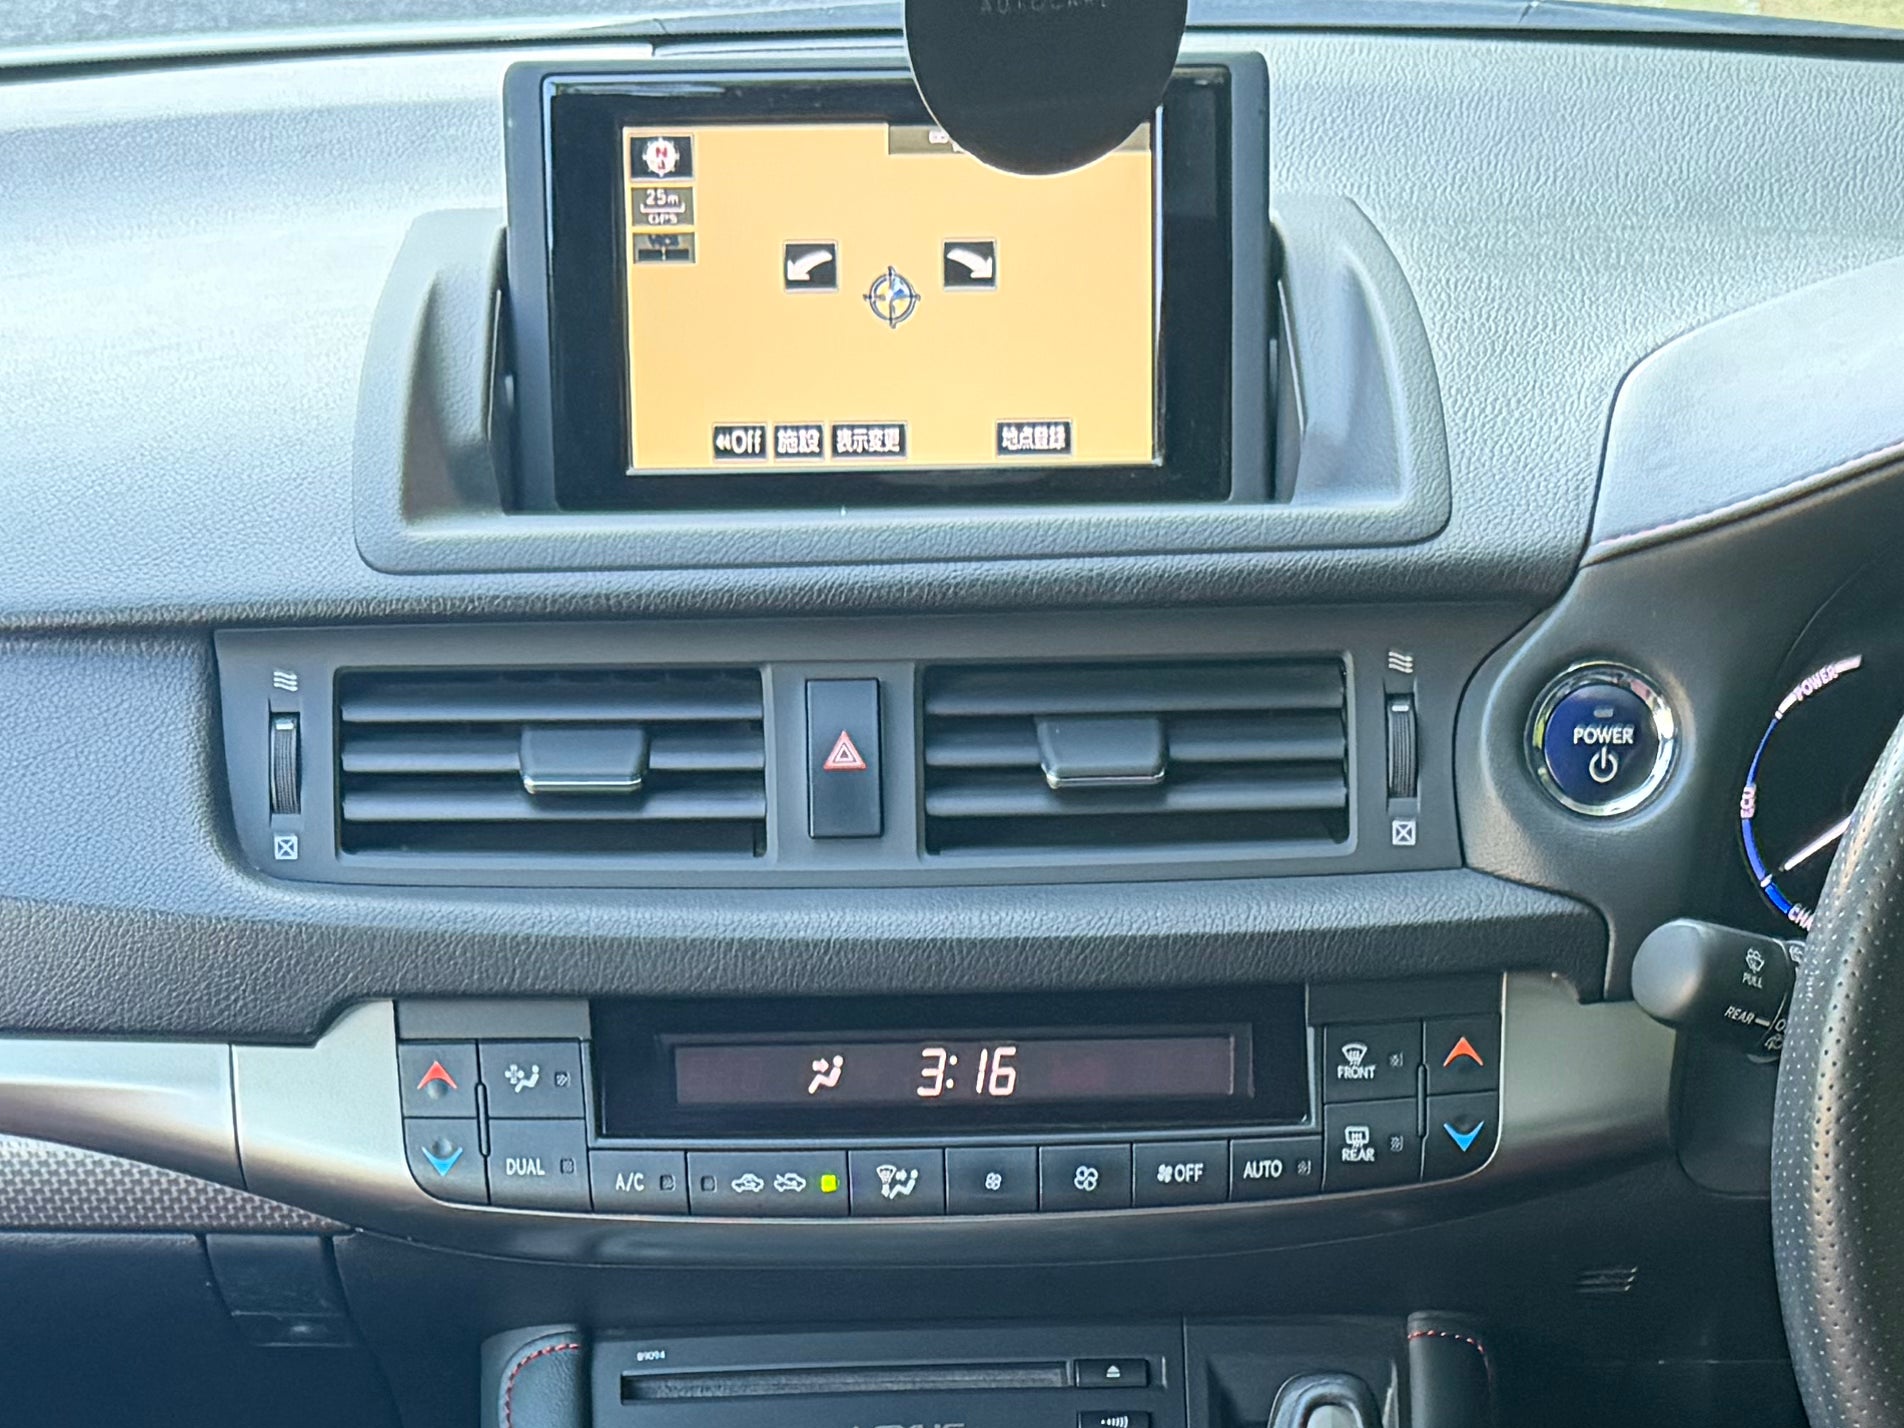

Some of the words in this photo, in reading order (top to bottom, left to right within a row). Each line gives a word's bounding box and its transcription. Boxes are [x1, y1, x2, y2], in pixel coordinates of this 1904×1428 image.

[1572, 726, 1635, 745] POWER
[1742, 972, 1763, 989] PULL
[1724, 1005, 1755, 1025] REAR
[917, 1046, 1017, 1097] 3:16
[1337, 1065, 1376, 1080] FRONT
[1341, 1148, 1375, 1162] REAR
[505, 1157, 546, 1176] DUAL
[1175, 1163, 1204, 1182] OFF
[1243, 1162, 1283, 1180] AUTO
[615, 1173, 645, 1192] A/C
